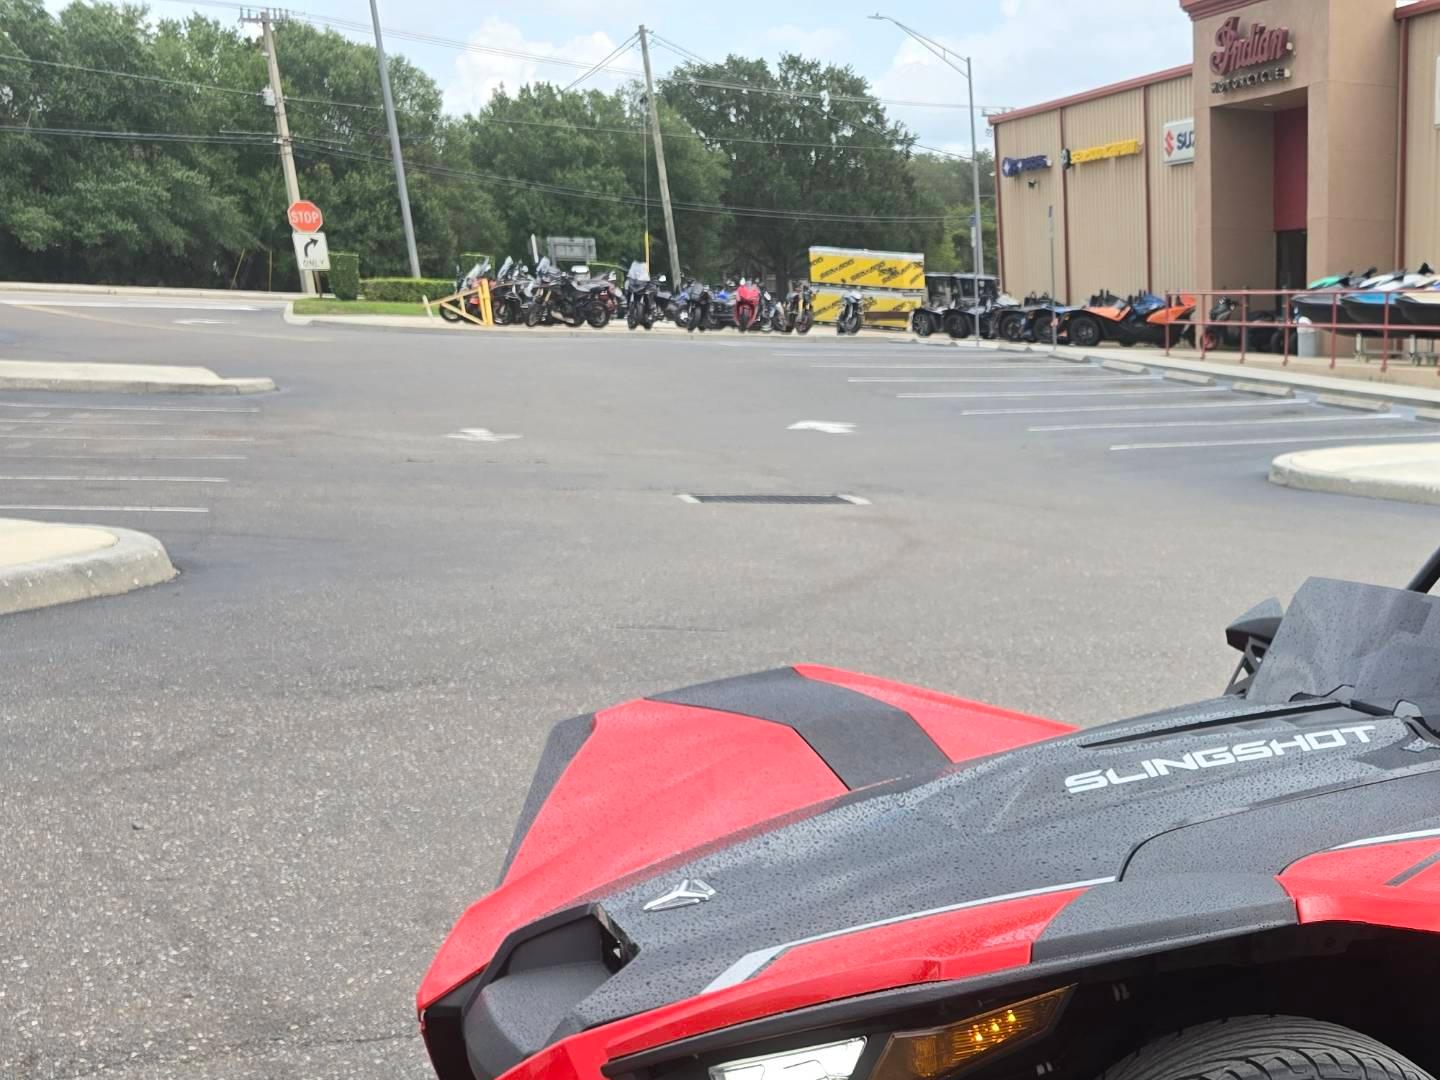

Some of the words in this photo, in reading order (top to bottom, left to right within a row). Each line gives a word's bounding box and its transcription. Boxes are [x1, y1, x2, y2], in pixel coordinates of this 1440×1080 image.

[1210, 17, 1288, 75] Indian
[290, 211, 319, 224] STOP
[1064, 725, 1376, 794] SLINGSHOT
